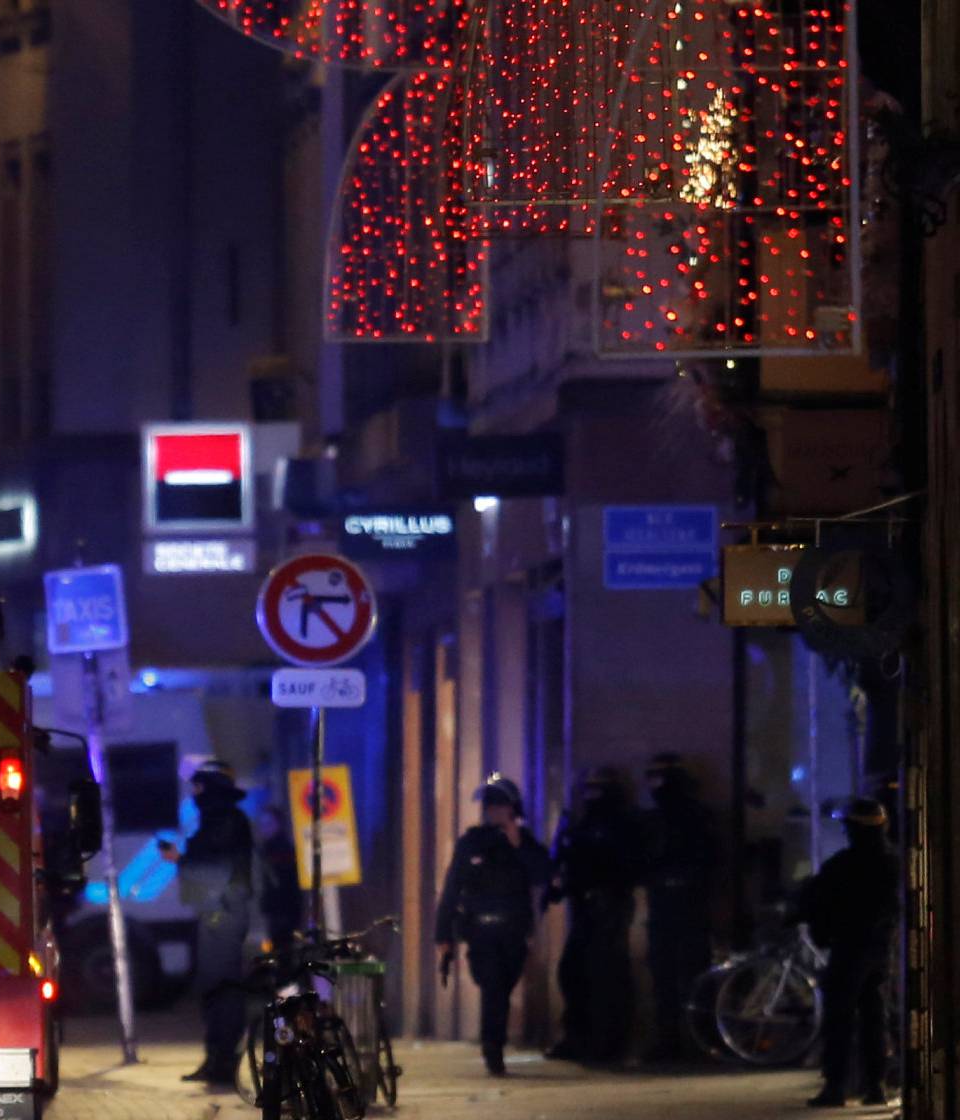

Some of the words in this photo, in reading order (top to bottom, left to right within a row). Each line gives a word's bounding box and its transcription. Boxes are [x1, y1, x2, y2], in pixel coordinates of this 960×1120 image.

[344, 515, 451, 534] CYRILLUS
[777, 568, 792, 584] D
[740, 590, 848, 606] FURAC
[53, 595, 115, 622] TAXIS
[279, 683, 315, 695] SAUF
